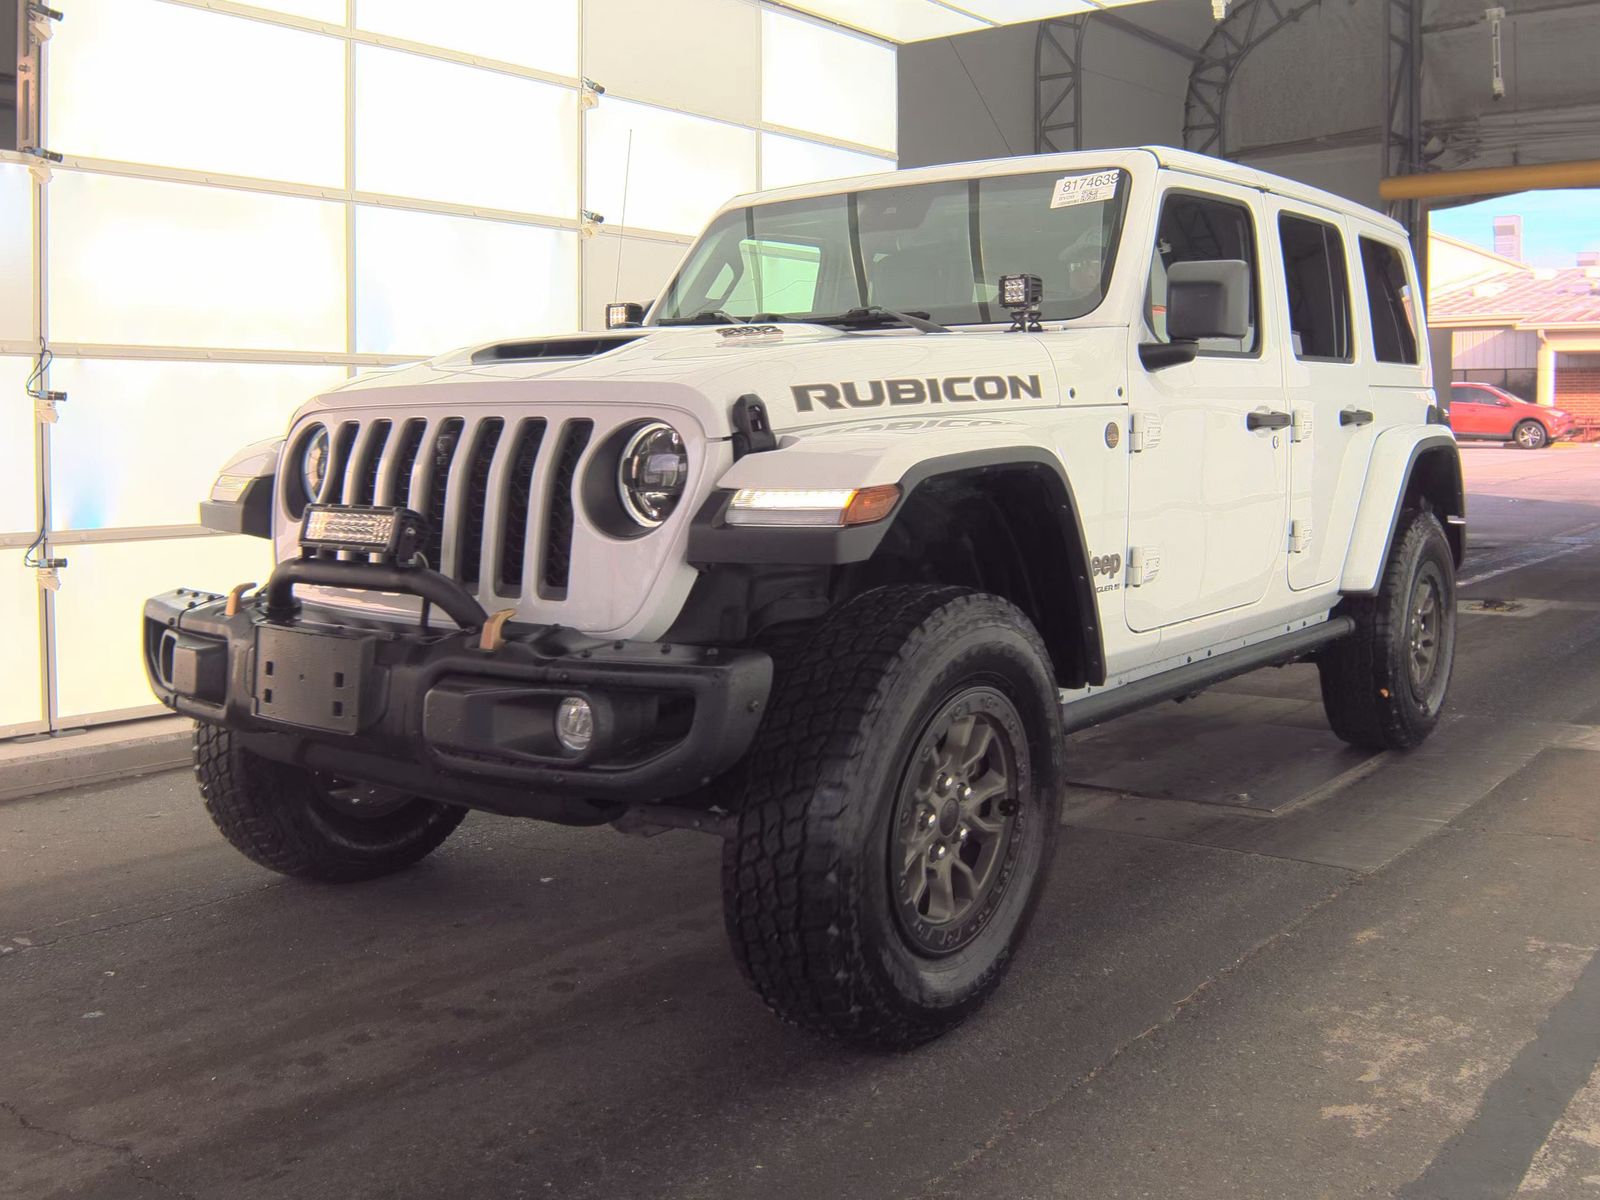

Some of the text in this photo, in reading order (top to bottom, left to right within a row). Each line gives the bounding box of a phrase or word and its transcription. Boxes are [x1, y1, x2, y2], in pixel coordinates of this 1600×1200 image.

[1062, 172, 1119, 193] 8174639
[789, 374, 1042, 413] RUBICON
[1089, 552, 1121, 579] eep
